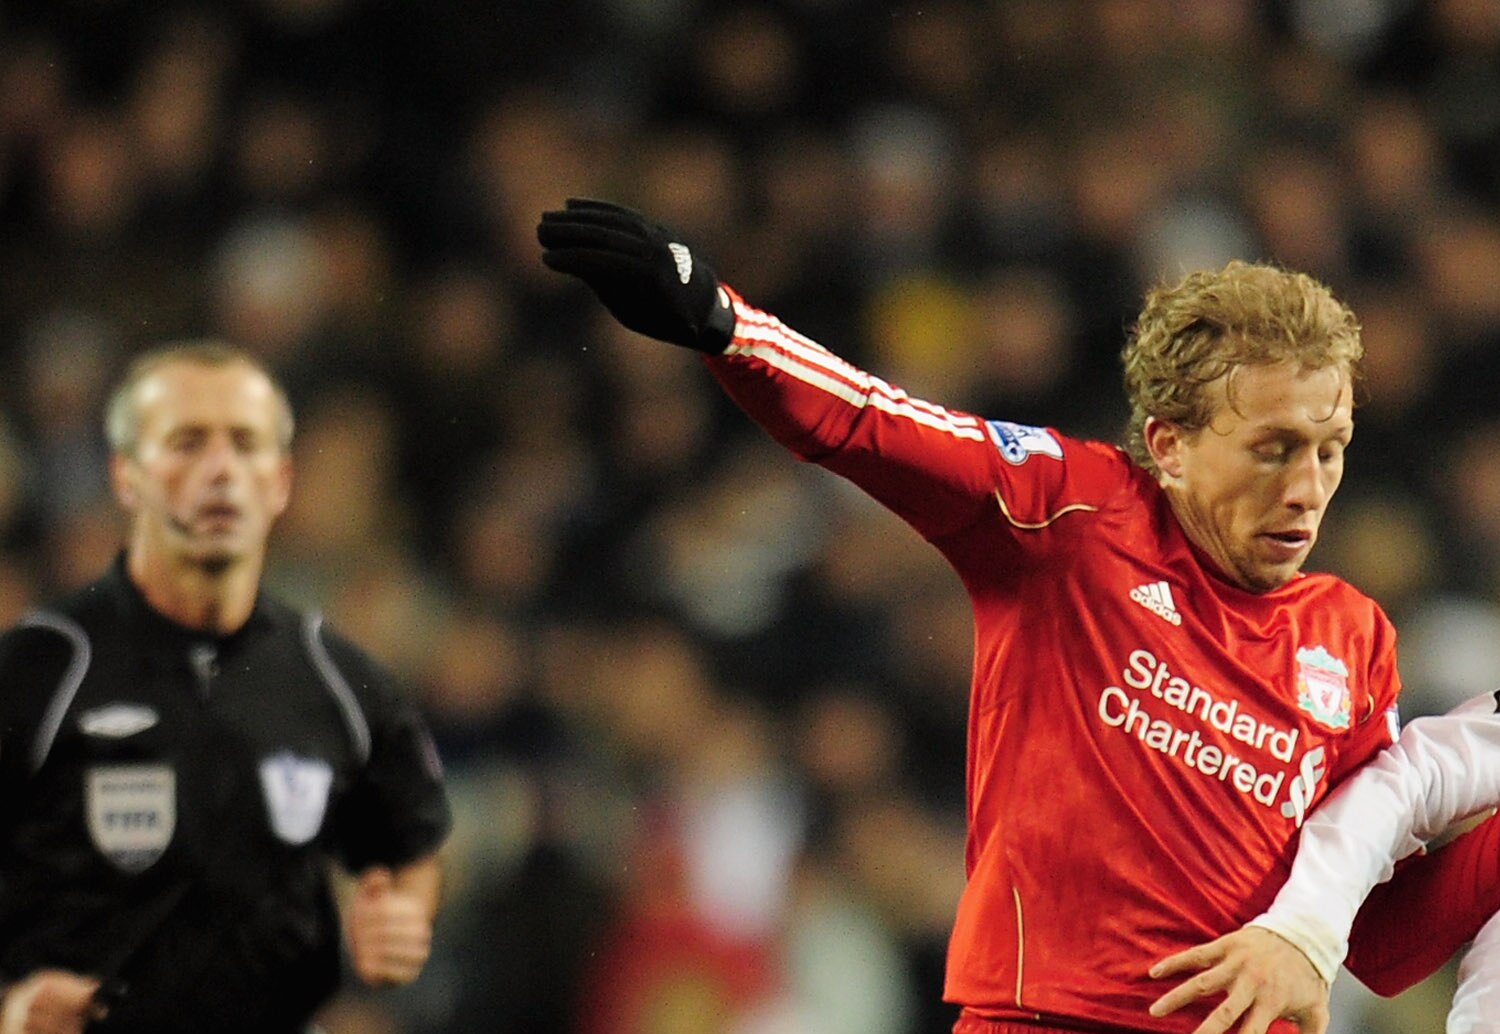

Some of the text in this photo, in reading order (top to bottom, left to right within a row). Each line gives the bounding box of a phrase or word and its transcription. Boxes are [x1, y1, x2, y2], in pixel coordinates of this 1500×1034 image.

[1129, 588, 1182, 627] adidas
[1098, 686, 1285, 807] Chartered
[1123, 649, 1299, 763] Standard
